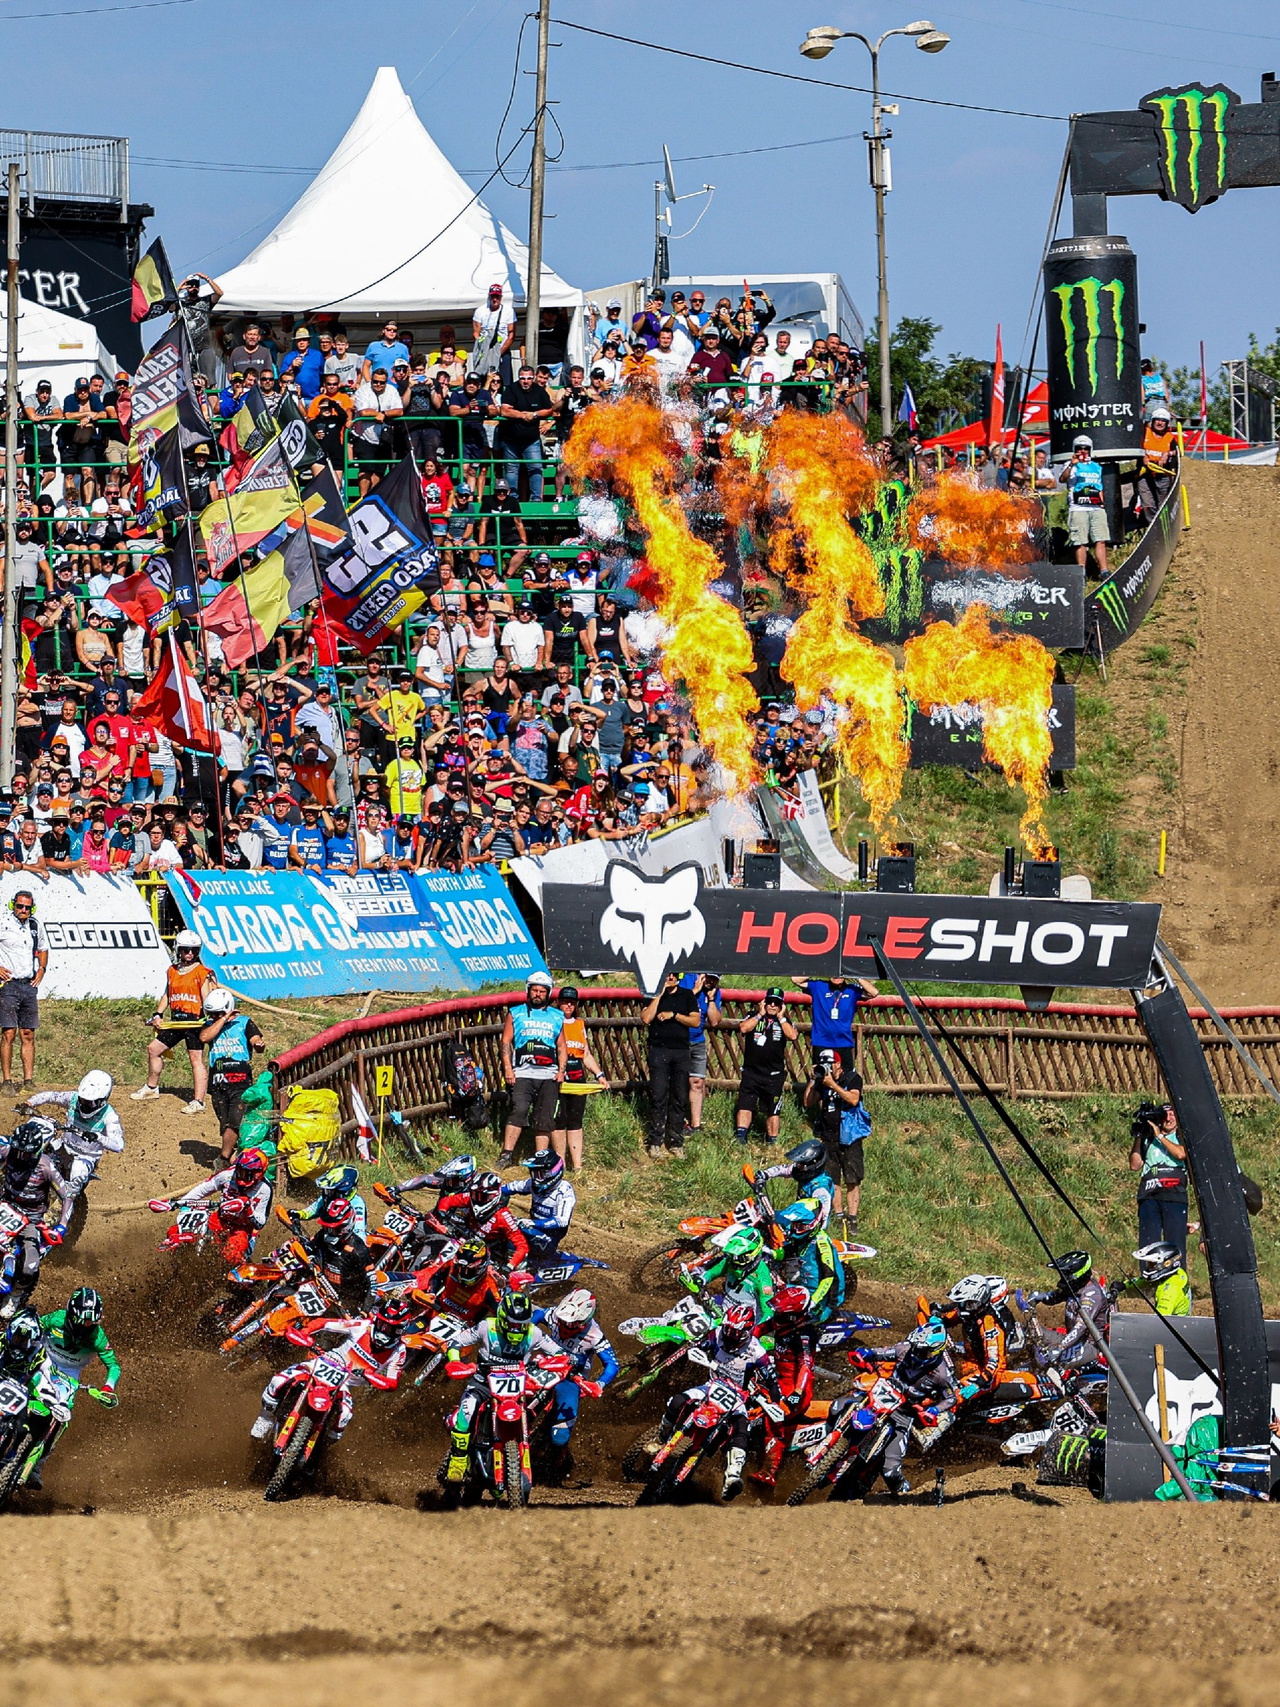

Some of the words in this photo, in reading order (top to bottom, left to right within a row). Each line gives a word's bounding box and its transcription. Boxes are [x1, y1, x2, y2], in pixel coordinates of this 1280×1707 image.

[1053, 403, 1134, 421] MONSTER
[1062, 420, 1123, 430] ENERGY
[326, 874, 378, 894] JAGO
[428, 877, 462, 893] NORTH
[463, 875, 487, 891] LAKE
[703, 863, 720, 888] LUB
[198, 879, 238, 896] NORTH
[243, 880, 275, 896] LAKE
[346, 896, 418, 916] GEERTS
[193, 903, 319, 956] GARDA
[431, 898, 528, 950] GARDA
[736, 911, 1129, 967] HOLESHOT
[220, 961, 285, 981] TRENTINO
[288, 959, 325, 977] ITALY
[346, 958, 414, 975] TRENTINO
[416, 956, 440, 973] ITALY
[460, 956, 508, 973] TRENTINO
[509, 953, 533, 970] ITALY
[523, 1020, 554, 1031] TRACK
[381, 1071, 389, 1088] 2
[178, 1213, 204, 1230] 48
[383, 1213, 410, 1233] 303
[734, 1203, 753, 1227] 311
[541, 1267, 568, 1281] 221
[297, 1290, 324, 1315] 45
[430, 1320, 457, 1340] 71
[818, 1331, 846, 1345] 87
[353, 1344, 381, 1369] HONDA
[314, 1363, 346, 1387] 243
[495, 1378, 520, 1394] 70
[709, 1387, 737, 1410] 92
[798, 1425, 823, 1443] 226
